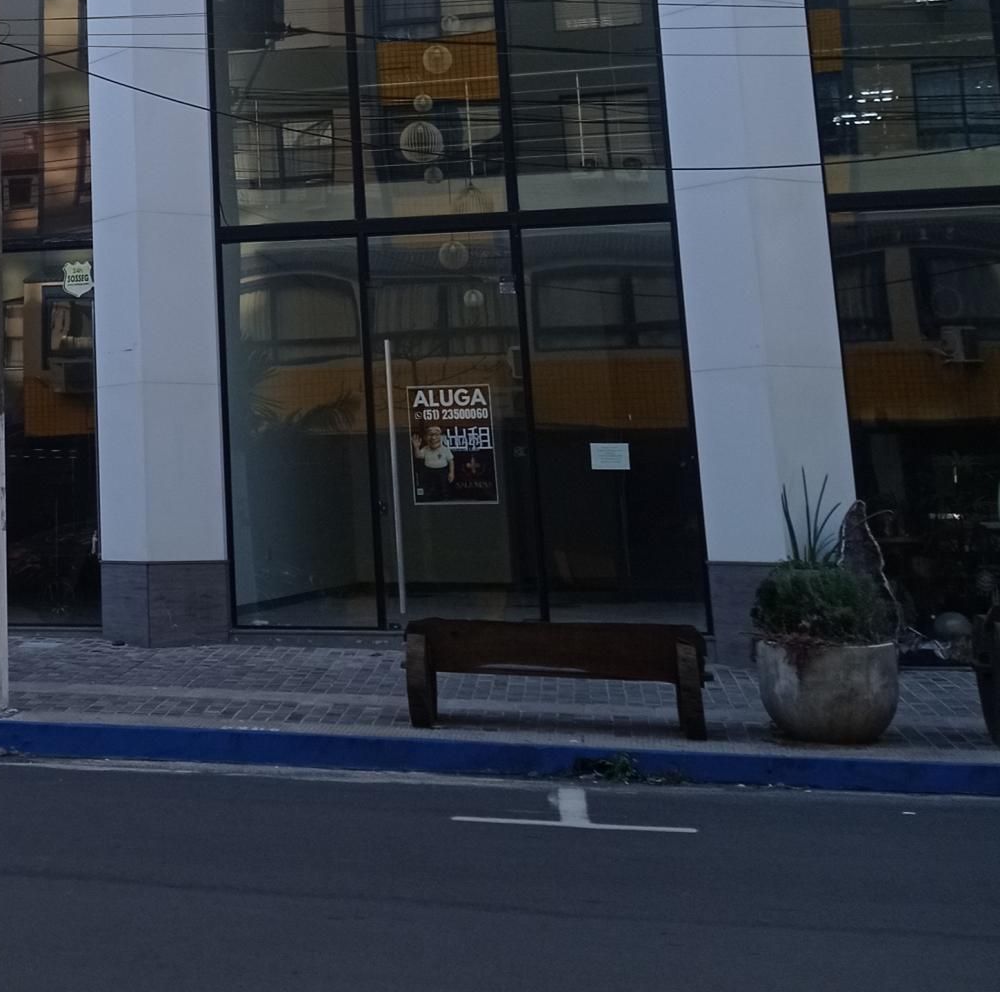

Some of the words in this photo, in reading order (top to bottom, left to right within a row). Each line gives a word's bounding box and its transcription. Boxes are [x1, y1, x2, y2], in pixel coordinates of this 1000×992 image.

[413, 388, 488, 408] ALUGA
[423, 409, 440, 420] (51)
[441, 408, 489, 420] 23500060
